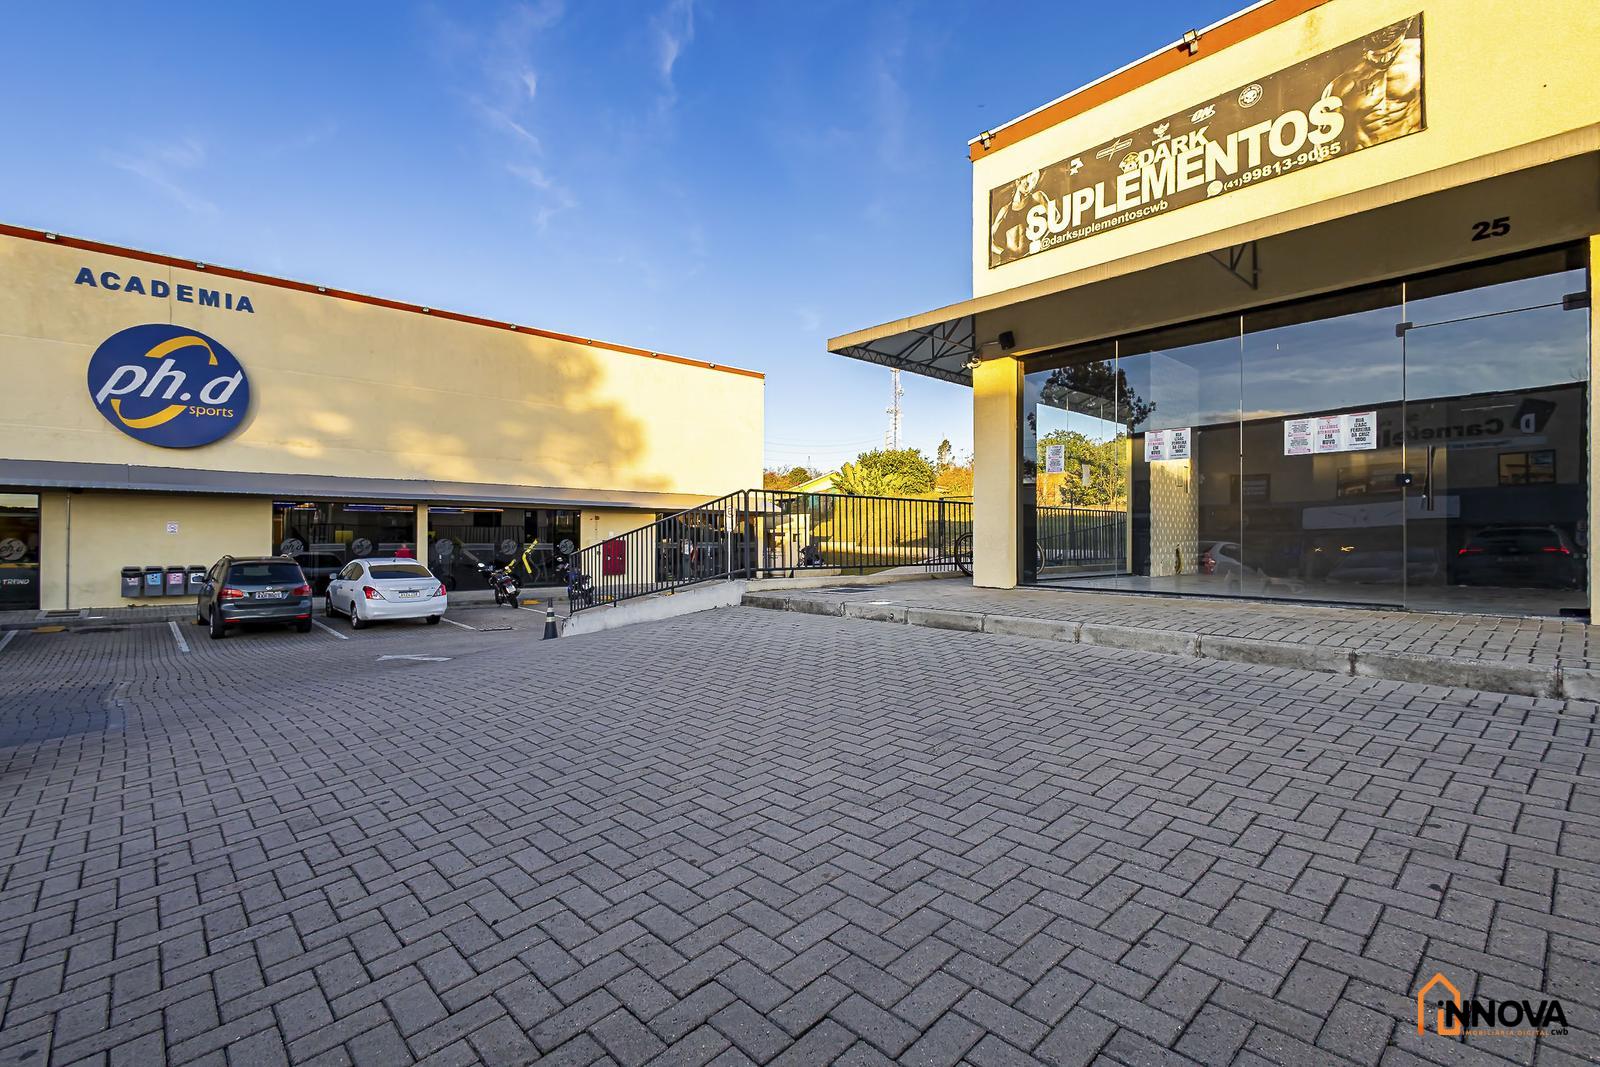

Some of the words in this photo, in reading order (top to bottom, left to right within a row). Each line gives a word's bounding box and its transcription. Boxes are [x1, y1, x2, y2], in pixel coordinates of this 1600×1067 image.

[1025, 95, 1345, 242] SUPLEMENTOS
[1139, 125, 1211, 167] DARK
[1040, 199, 1169, 249] @darksuplementoscwb
[1471, 216, 1511, 242] 25
[74, 267, 255, 314] ACADEMIA
[95, 358, 244, 405] ph.d
[189, 405, 234, 418] sports
